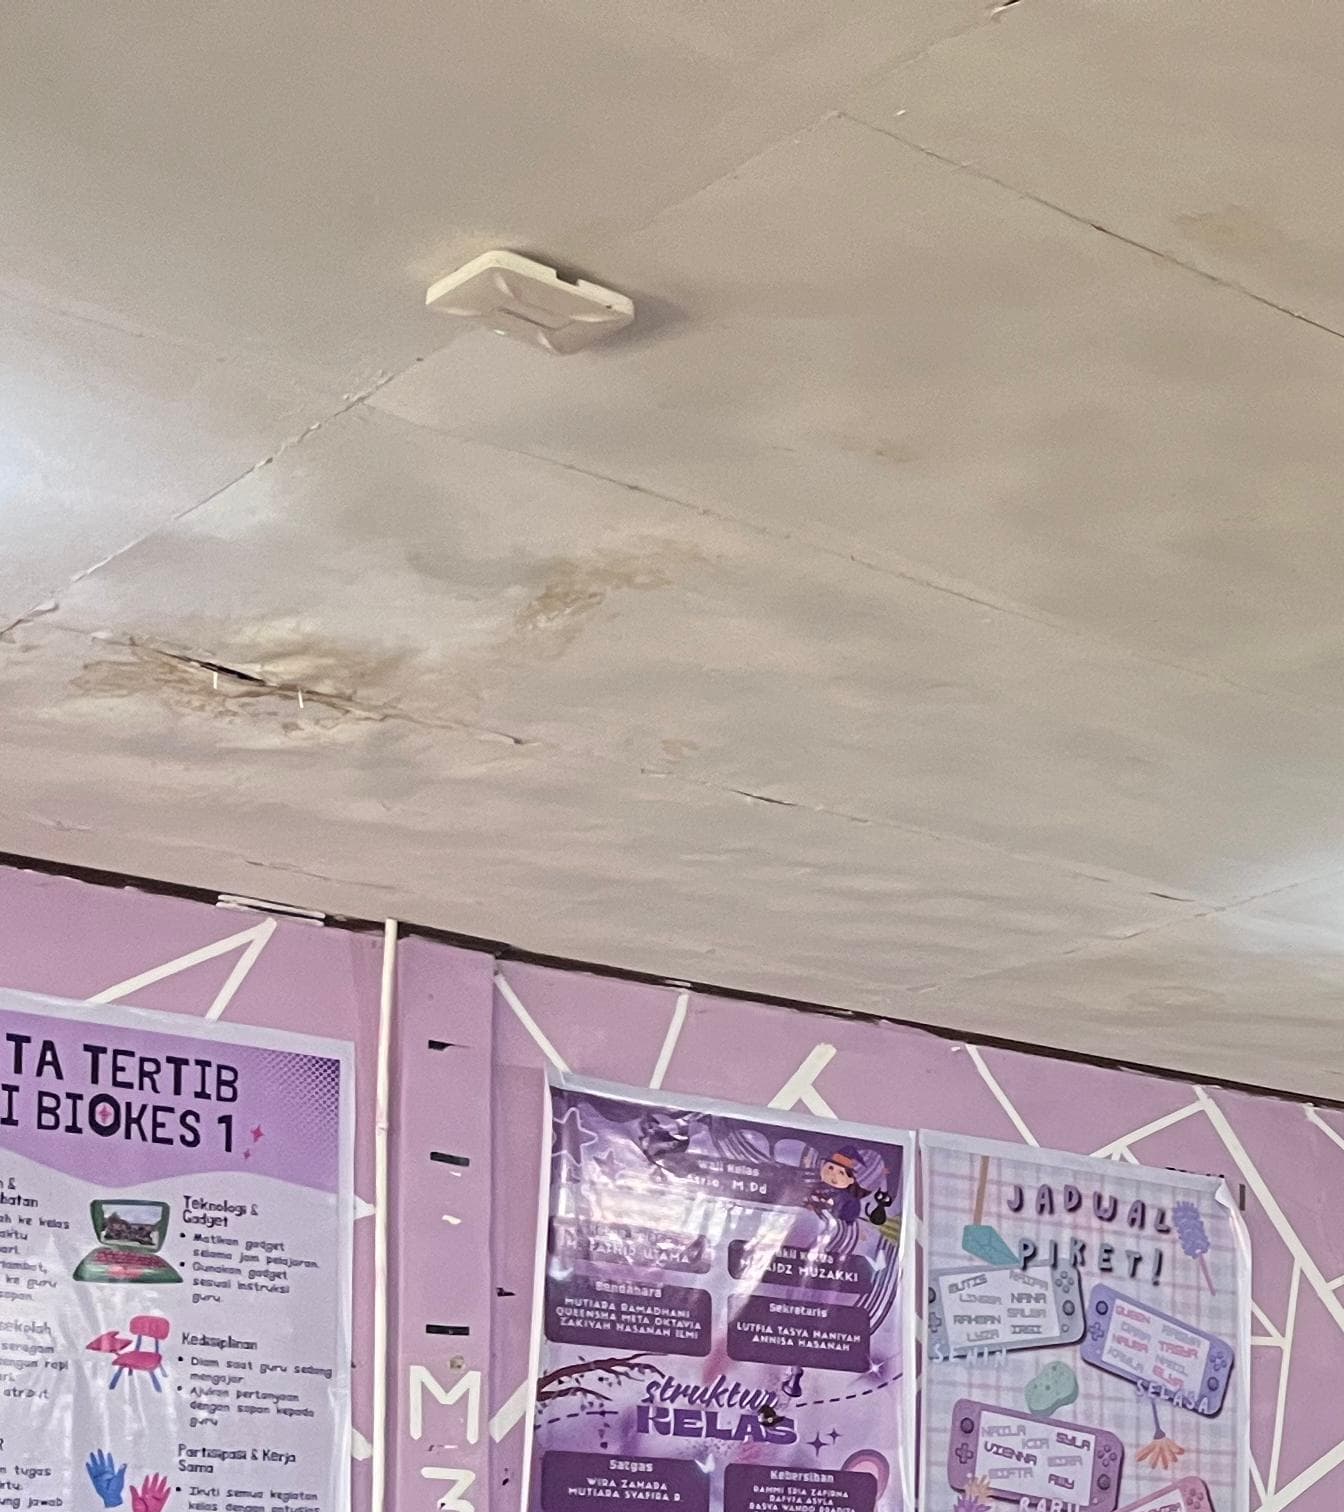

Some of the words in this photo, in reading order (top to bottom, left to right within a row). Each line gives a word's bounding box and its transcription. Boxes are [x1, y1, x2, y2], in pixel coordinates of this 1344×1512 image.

[82, 1043, 239, 1103] TERTIB
[36, 1091, 201, 1149] BIOKES
[217, 1114, 233, 1153] 1
[183, 1195, 247, 1217] Teknologi
[250, 1204, 259, 1216] &
[183, 1209, 228, 1228] Gadget
[193, 1233, 239, 1246] Matikan
[245, 1240, 285, 1253] gadget
[193, 1249, 232, 1260] selama
[239, 1252, 260, 1263] jam
[1019, 1238, 1164, 1285] PIKET!
[192, 1261, 242, 1275] Gunakan
[248, 1269, 288, 1281] gadget
[799, 1266, 859, 1282] MUZAKKI
[564, 1298, 616, 1311] MUTIARA
[769, 1303, 828, 1318] Sekretaris
[654, 1318, 702, 1330] OKTAVIA
[778, 1326, 809, 1338] TASYA
[752, 1335, 794, 1346] ANNISA
[191, 1356, 219, 1368] Diam
[226, 1360, 253, 1370] saat
[260, 1363, 287, 1374] guru
[236, 1389, 300, 1404] pertanyaan
[1136, 1380, 1209, 1414] SELASA
[237, 1404, 271, 1415] sopan
[636, 1405, 798, 1445] KELAS
[178, 1443, 247, 1461] Partisipasi
[250, 1449, 259, 1461] &
[262, 1449, 296, 1465] Kerja
[15, 1465, 52, 1479] tugas
[178, 1459, 214, 1473] Sama
[609, 1460, 653, 1472] Satgas
[770, 1470, 834, 1483] Kebersihan
[226, 1489, 264, 1499] semua
[270, 1489, 318, 1503] kegiatan
[188, 1501, 218, 1512] kelas
